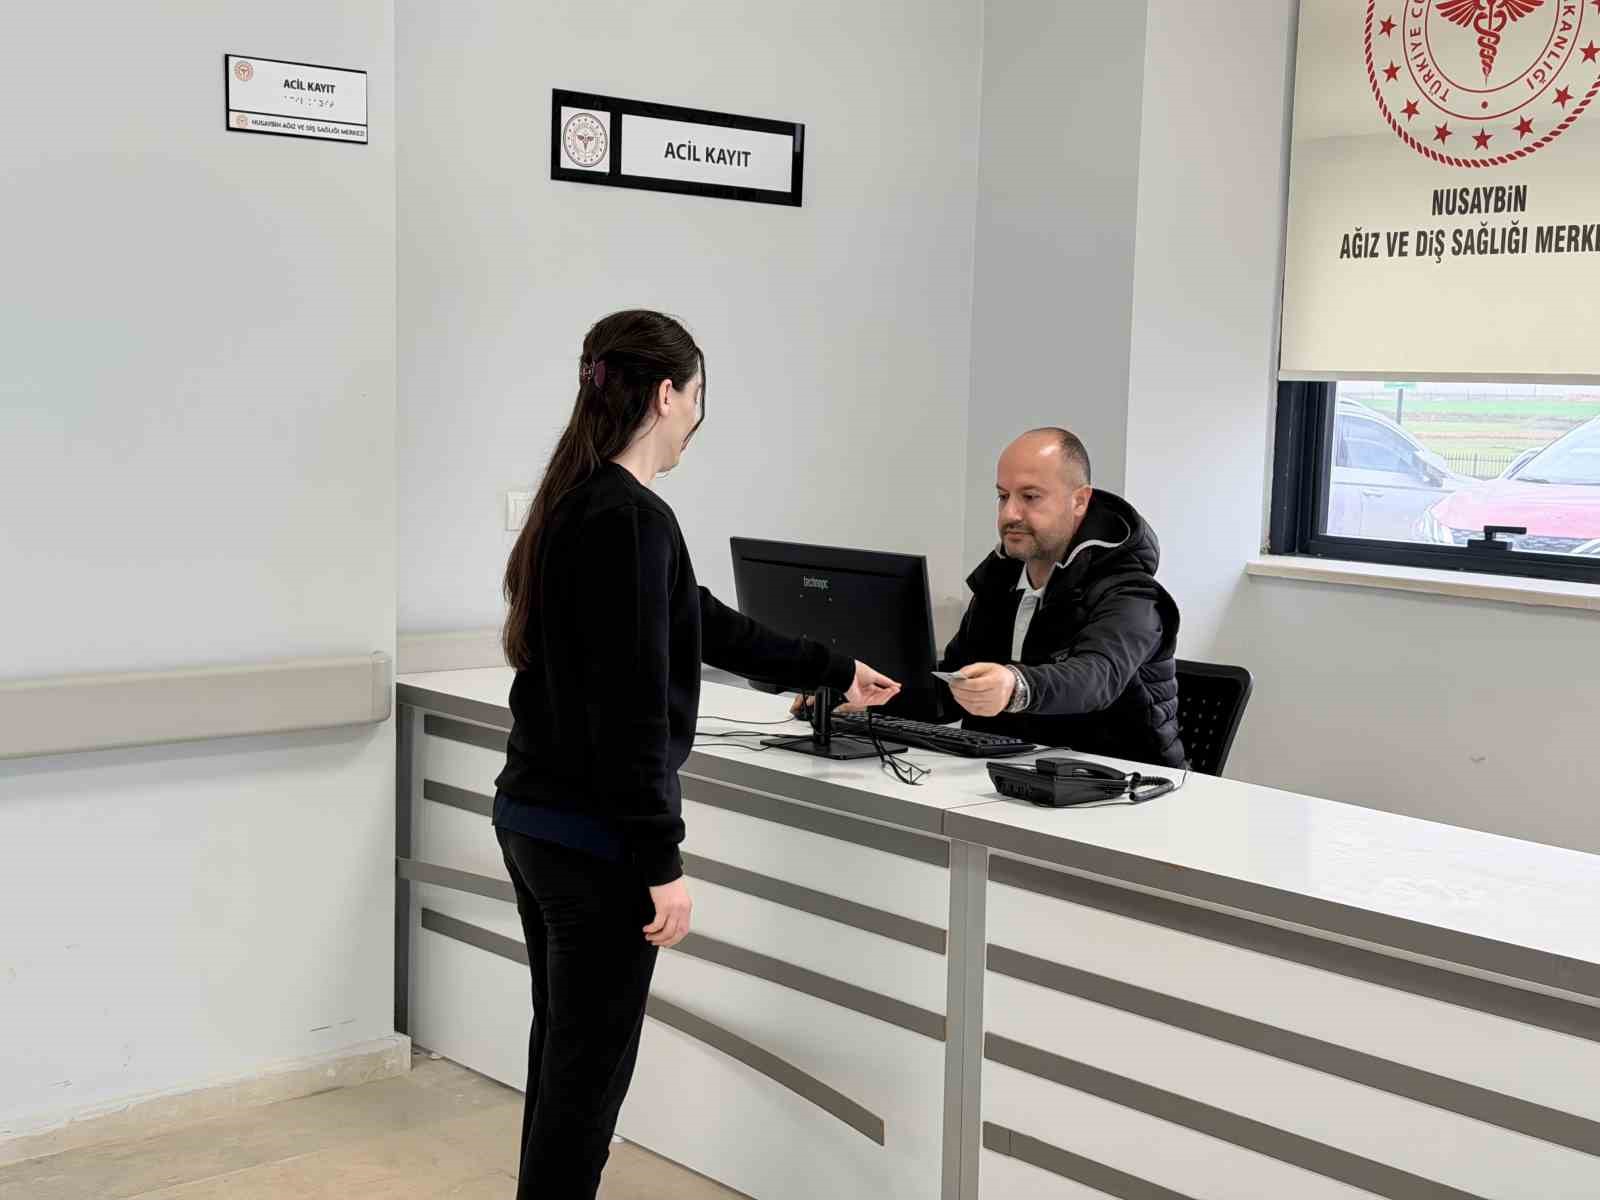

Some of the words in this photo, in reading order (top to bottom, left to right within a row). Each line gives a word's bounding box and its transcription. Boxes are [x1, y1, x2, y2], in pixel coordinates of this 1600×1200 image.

[1525, 0, 1576, 90] KANLIĞI
[283, 78, 306, 91] ACİL
[307, 82, 336, 94] KAYIT
[664, 140, 701, 162] ACİL
[705, 146, 752, 167] KAYIT
[1340, 226, 1380, 259] AĞIZ
[1386, 231, 1409, 258] VE
[1451, 220, 1528, 256] SAĞLIĞI
